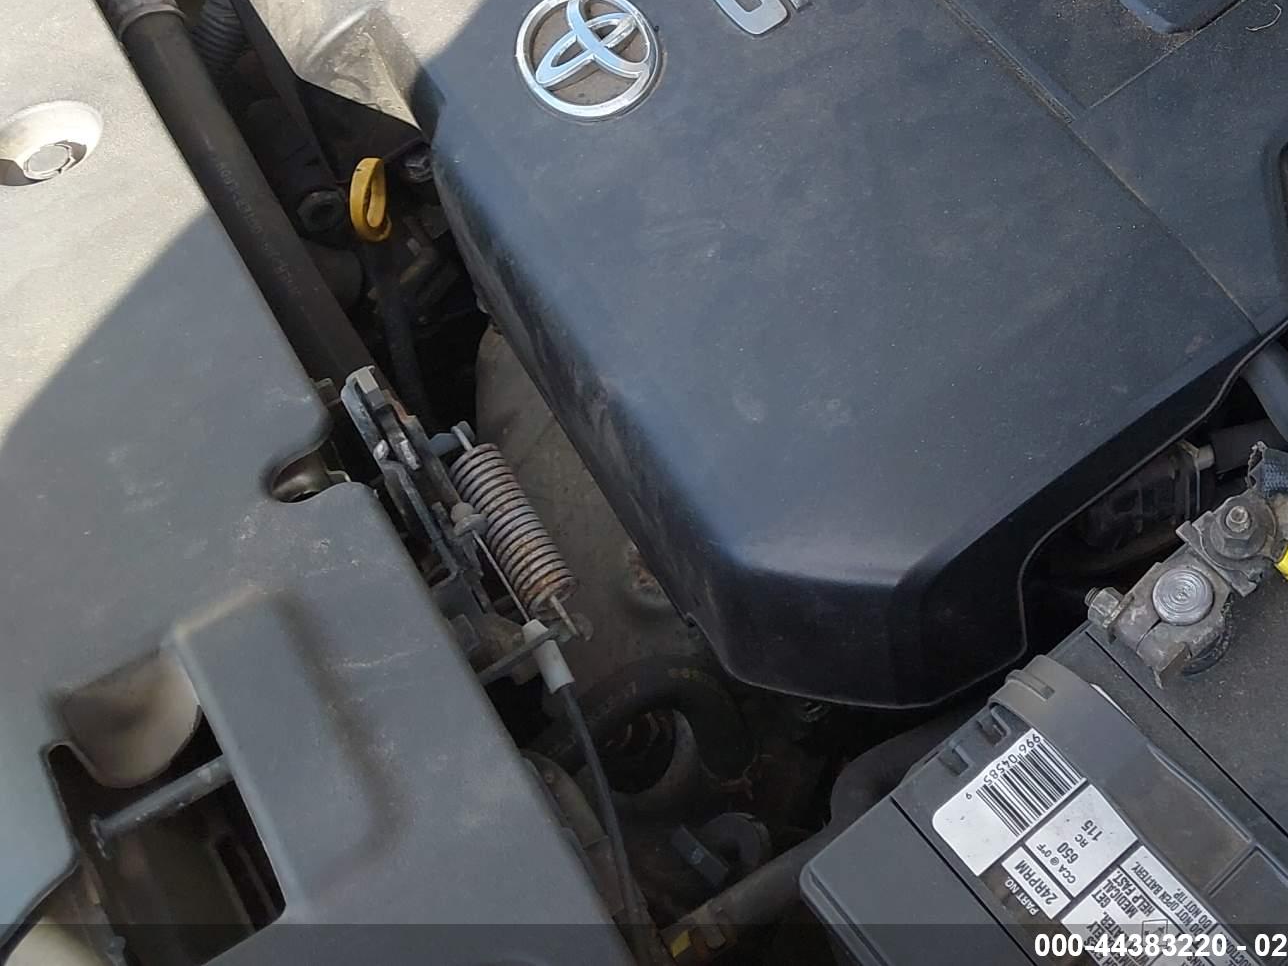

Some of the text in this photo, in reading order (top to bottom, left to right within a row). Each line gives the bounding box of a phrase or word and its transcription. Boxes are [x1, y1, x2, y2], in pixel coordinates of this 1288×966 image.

[982, 752, 1017, 786] 04585
[1073, 832, 1088, 847] RC
[1080, 818, 1104, 842] 115
[1047, 854, 1061, 867] @
[1056, 840, 1079, 864] 650
[1014, 858, 1058, 906] 24RPRM
[1055, 863, 1076, 885] CCA
[1110, 869, 1136, 895] FAST.
[1130, 861, 1162, 894] BATTERY.
[1002, 875, 1039, 916] PART NO.
[1091, 888, 1111, 908] GET
[1101, 878, 1138, 918] MEDICAL
[1131, 892, 1155, 916] HELP
[1158, 890, 1178, 911] OPEN
[1171, 887, 1212, 929] DO NOT TIP.
[1173, 907, 1192, 926] NOT
[1188, 923, 1202, 937] DO
